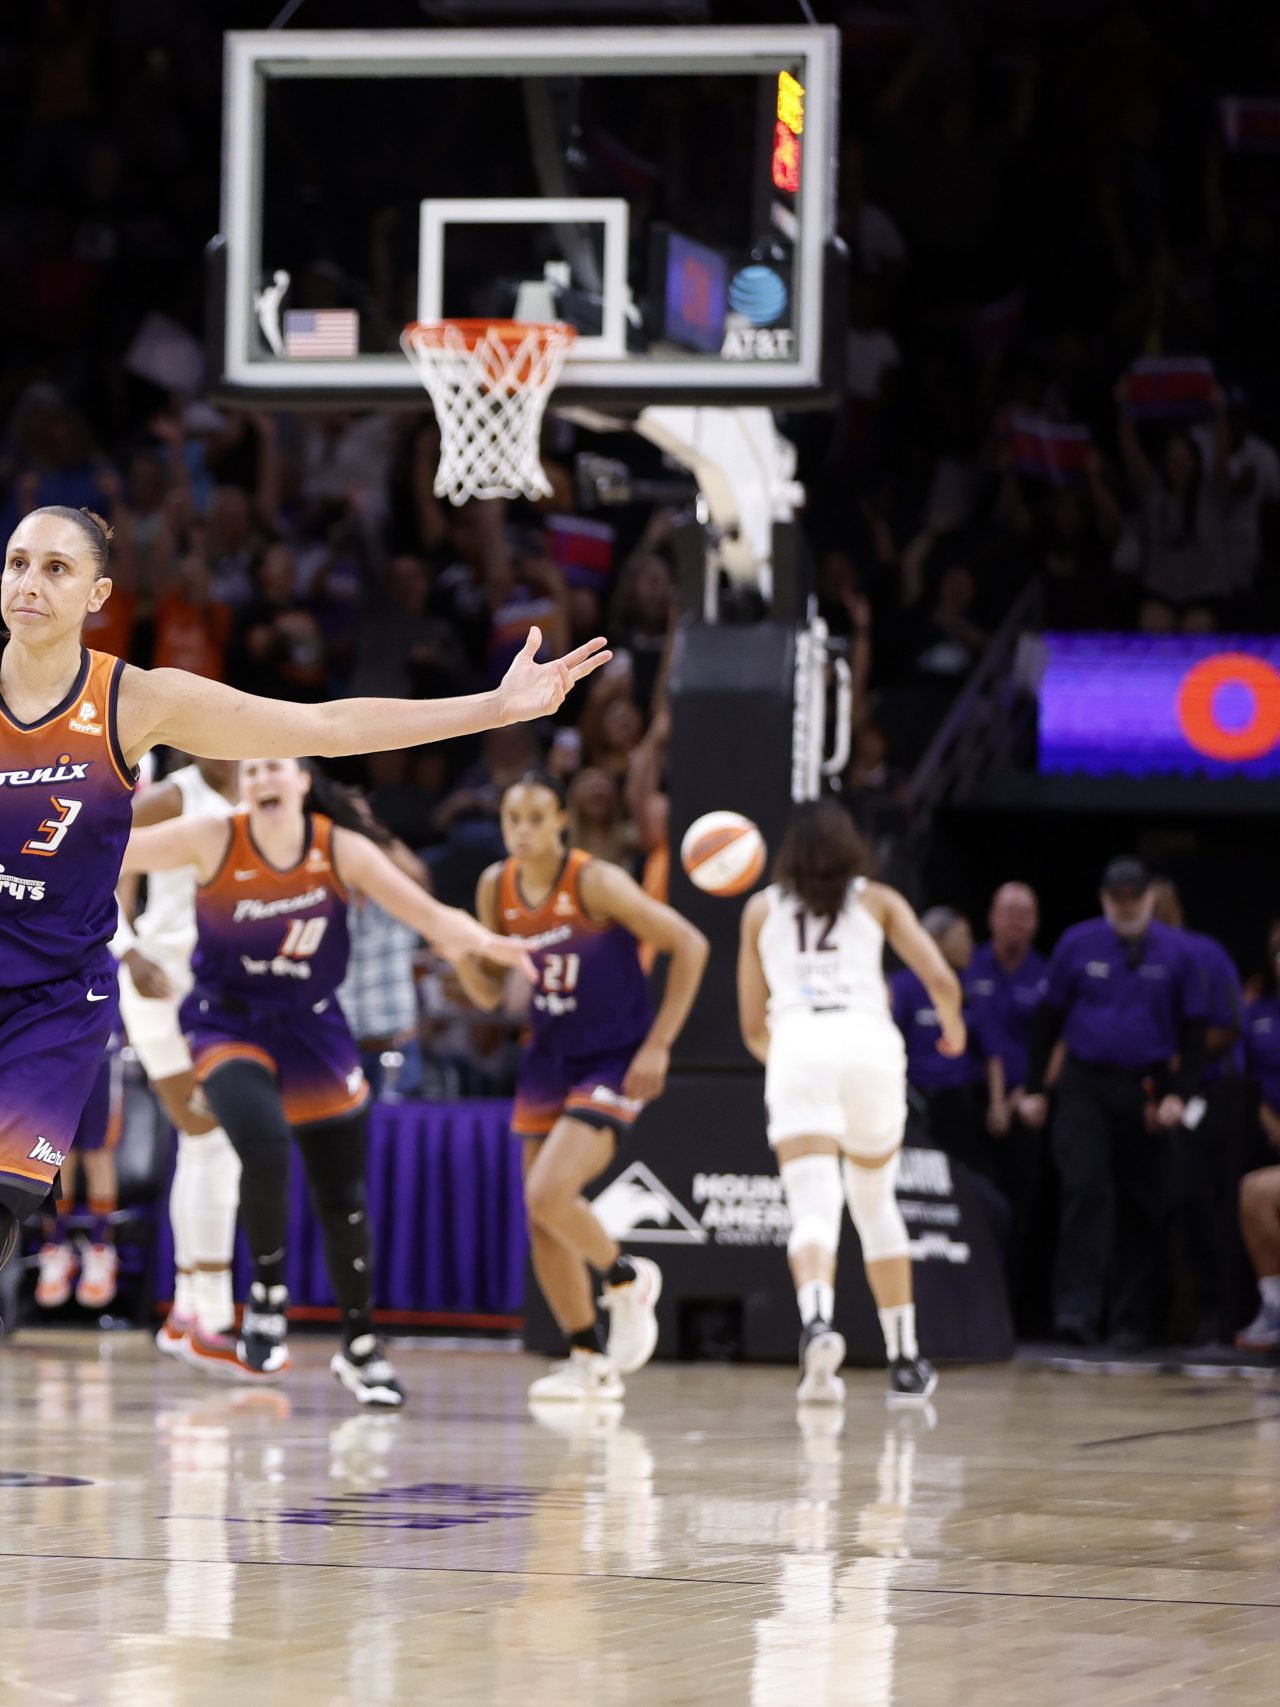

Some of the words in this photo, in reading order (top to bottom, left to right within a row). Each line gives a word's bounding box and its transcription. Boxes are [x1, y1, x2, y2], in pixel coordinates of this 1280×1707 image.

[721, 328, 793, 359] AT&T
[70, 719, 101, 734] PayPal
[21, 795, 83, 857] 3
[278, 916, 328, 958] 10
[792, 909, 839, 953] 12
[543, 952, 580, 993] 21
